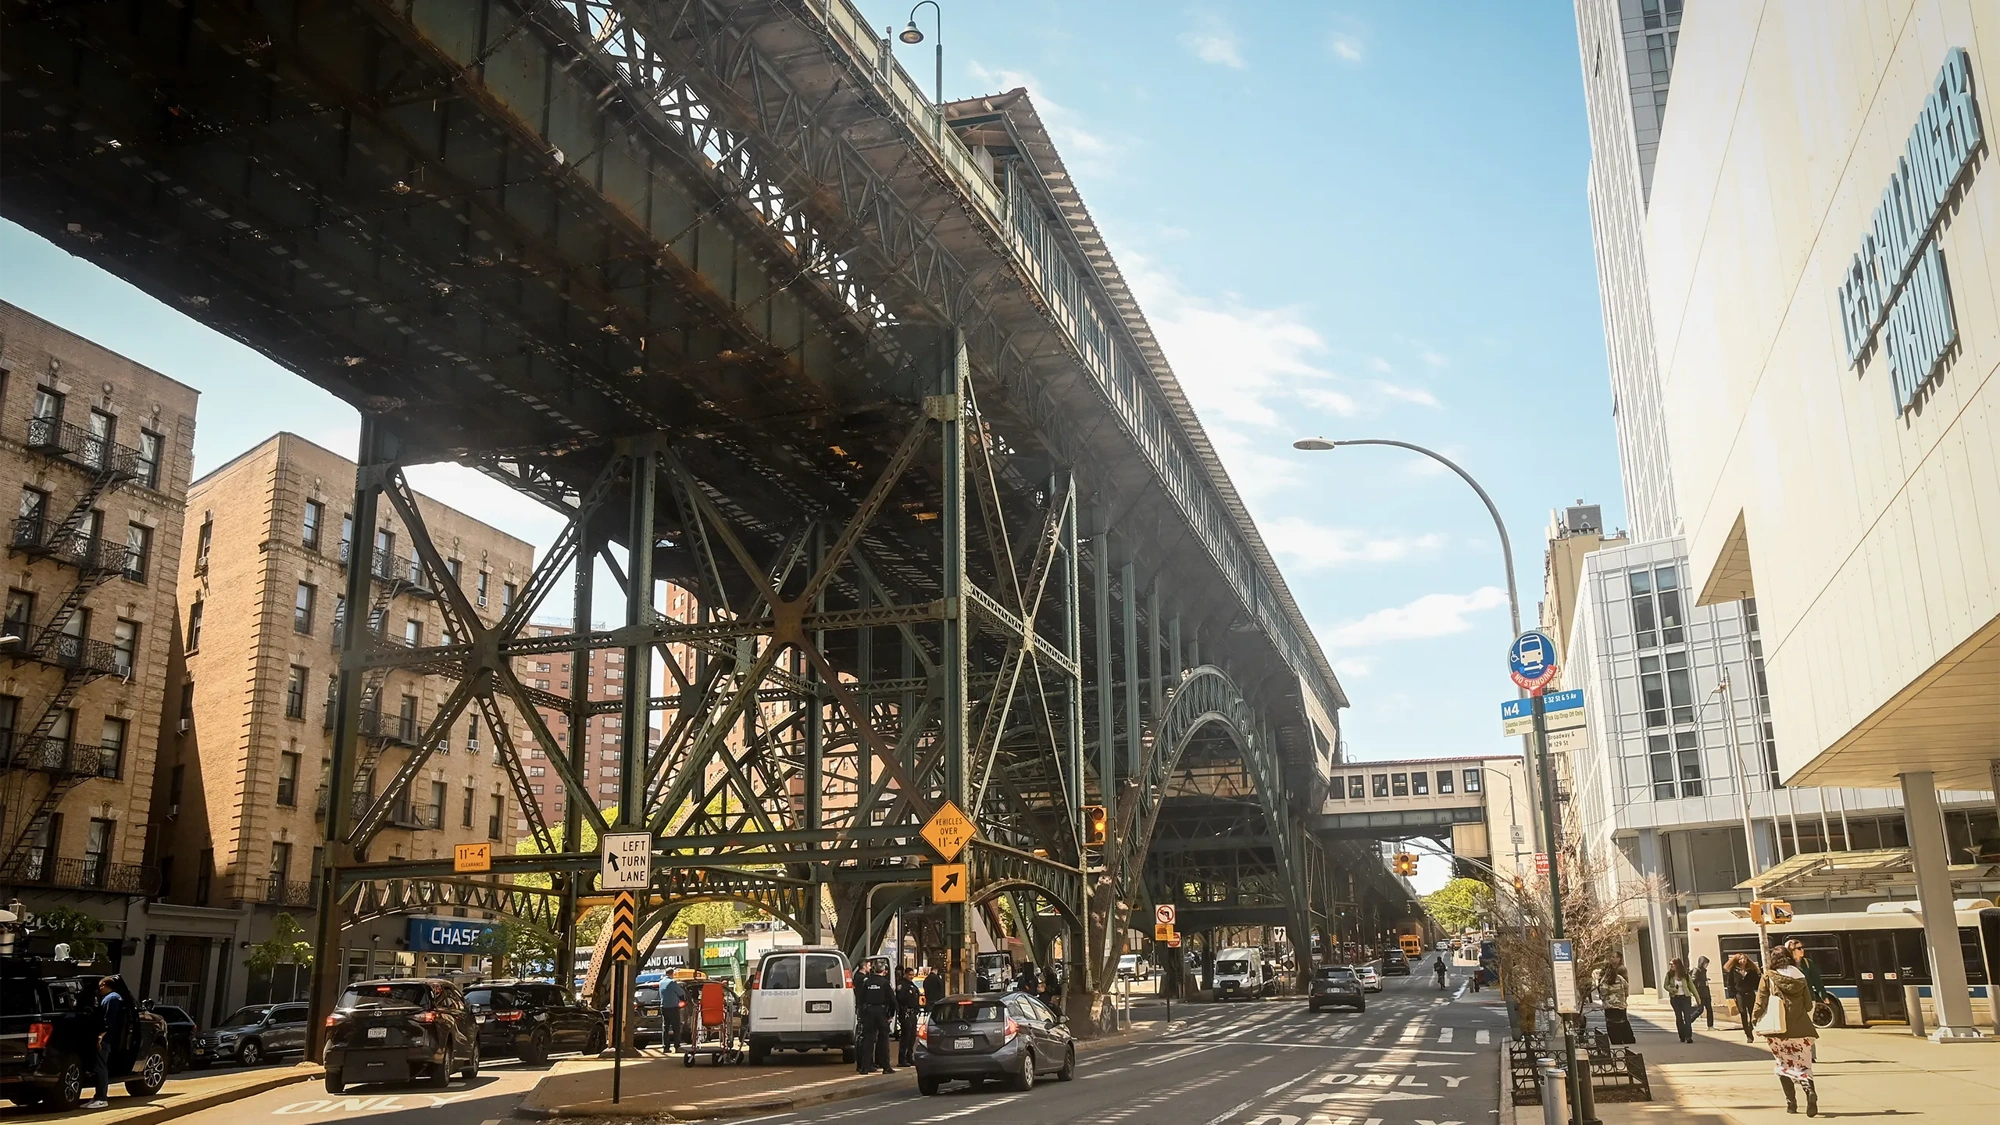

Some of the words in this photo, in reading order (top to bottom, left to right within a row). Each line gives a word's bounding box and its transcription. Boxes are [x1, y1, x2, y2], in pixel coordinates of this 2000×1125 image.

[1838, 253, 1871, 371] LEE
[1871, 46, 1983, 307] BOLLINGER
[1884, 240, 1958, 420] FORUM
[1514, 673, 1524, 684] NO
[1523, 669, 1554, 687] STANDING
[1503, 702, 1520, 717] M4
[1547, 733, 1571, 741] Broadway
[935, 817, 963, 826] VEHICLES
[940, 827, 958, 835] OVER
[622, 841, 646, 852] LEFT
[621, 855, 646, 867] TURN
[620, 870, 645, 882] LANE
[431, 927, 480, 946] CHASE
[704, 944, 739, 959] SUBWAY
[662, 955, 684, 967] GRILL
[1319, 1073, 1471, 1088] ONLY
[270, 1094, 473, 1115] ONLY
